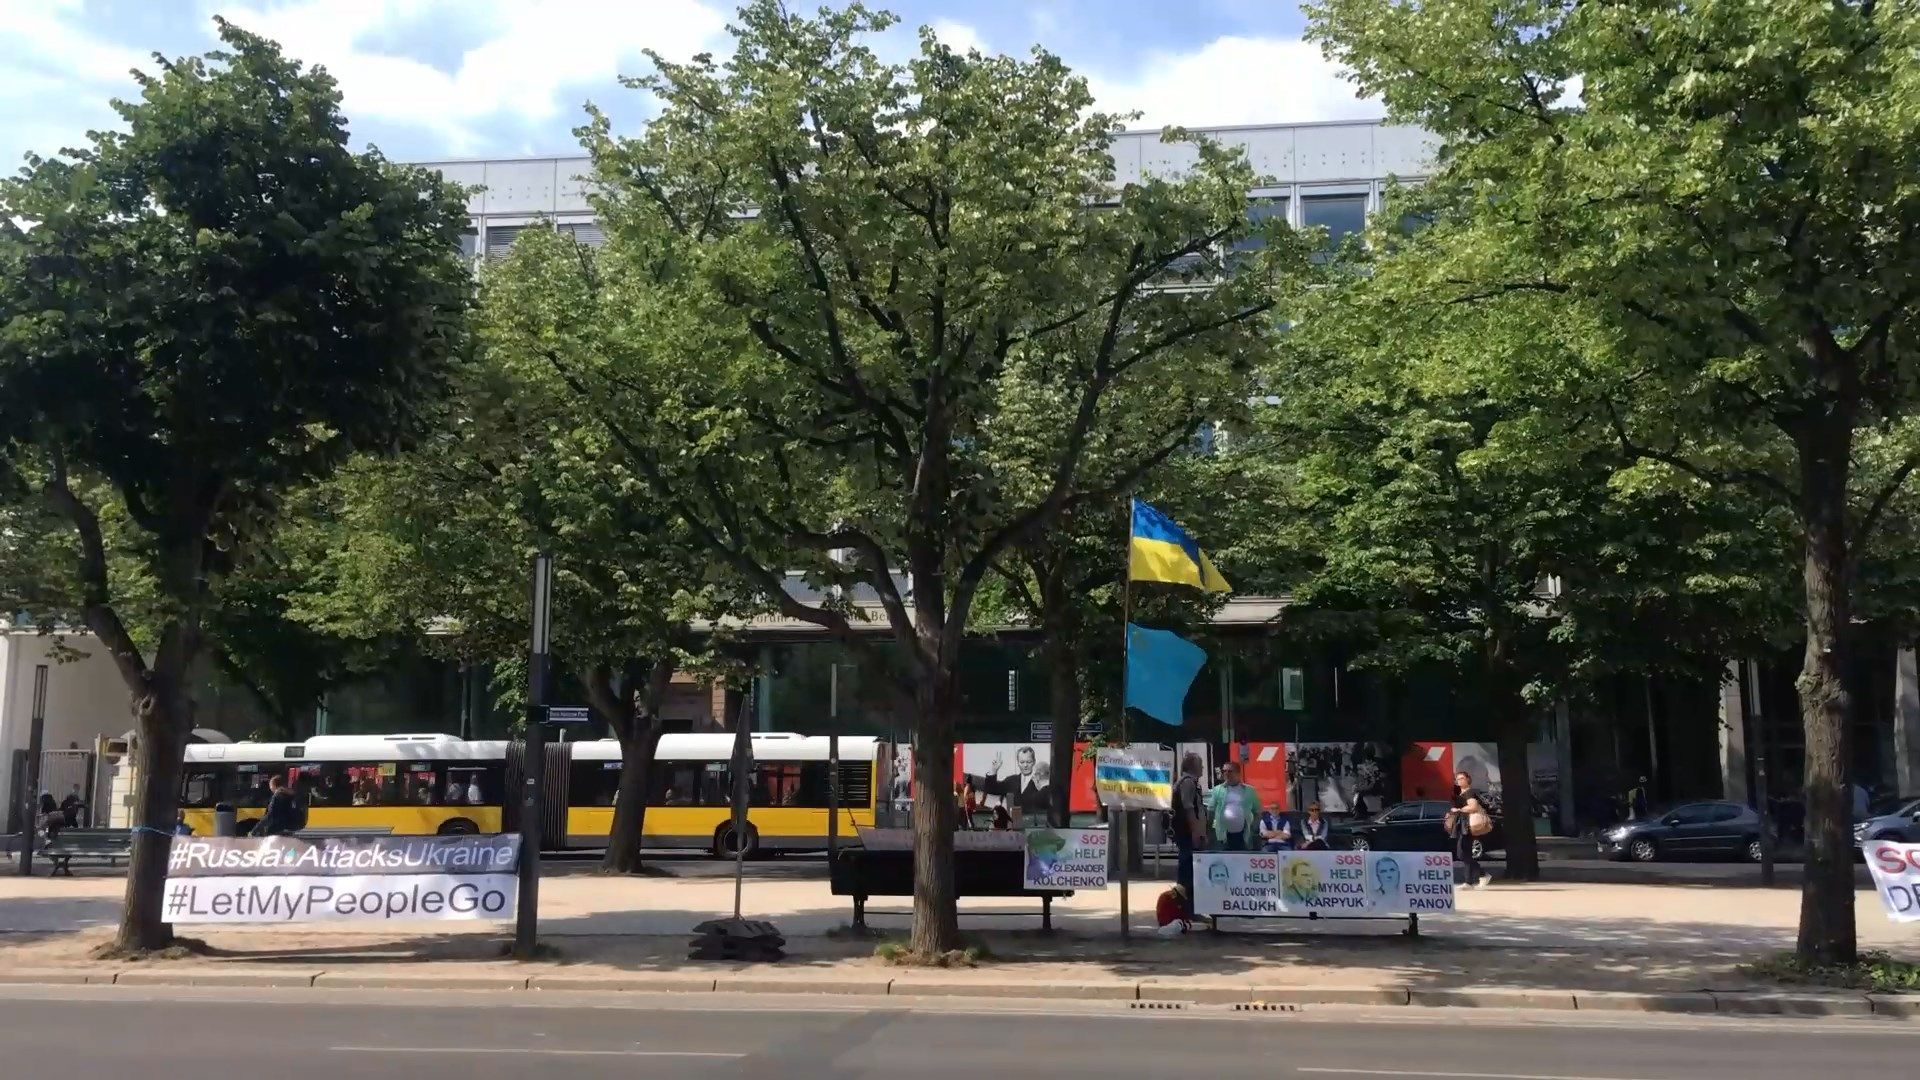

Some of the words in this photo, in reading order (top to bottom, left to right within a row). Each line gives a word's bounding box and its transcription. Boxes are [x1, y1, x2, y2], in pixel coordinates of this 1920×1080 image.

[1081, 834, 1106, 845] SOS
[1075, 848, 1106, 859] HELP
[1249, 858, 1276, 870] SOS
[1335, 854, 1362, 866] SOS
[1424, 855, 1451, 867] SOS
[1053, 863, 1105, 873] OLEXANDER
[1330, 868, 1364, 880] HELP
[1034, 875, 1106, 887] KOLCHENKO
[1244, 872, 1276, 883] HELP
[1418, 869, 1452, 881] HELP
[1229, 887, 1277, 897] VOLODYMYR
[1318, 882, 1364, 894] MYKOLA
[1405, 883, 1453, 895] EVGENI
[168, 883, 505, 920] #LetMyPeopleGo
[1222, 900, 1276, 911] BALUKH
[1304, 897, 1364, 908] KARPYUK
[1409, 898, 1453, 909] PANOV
